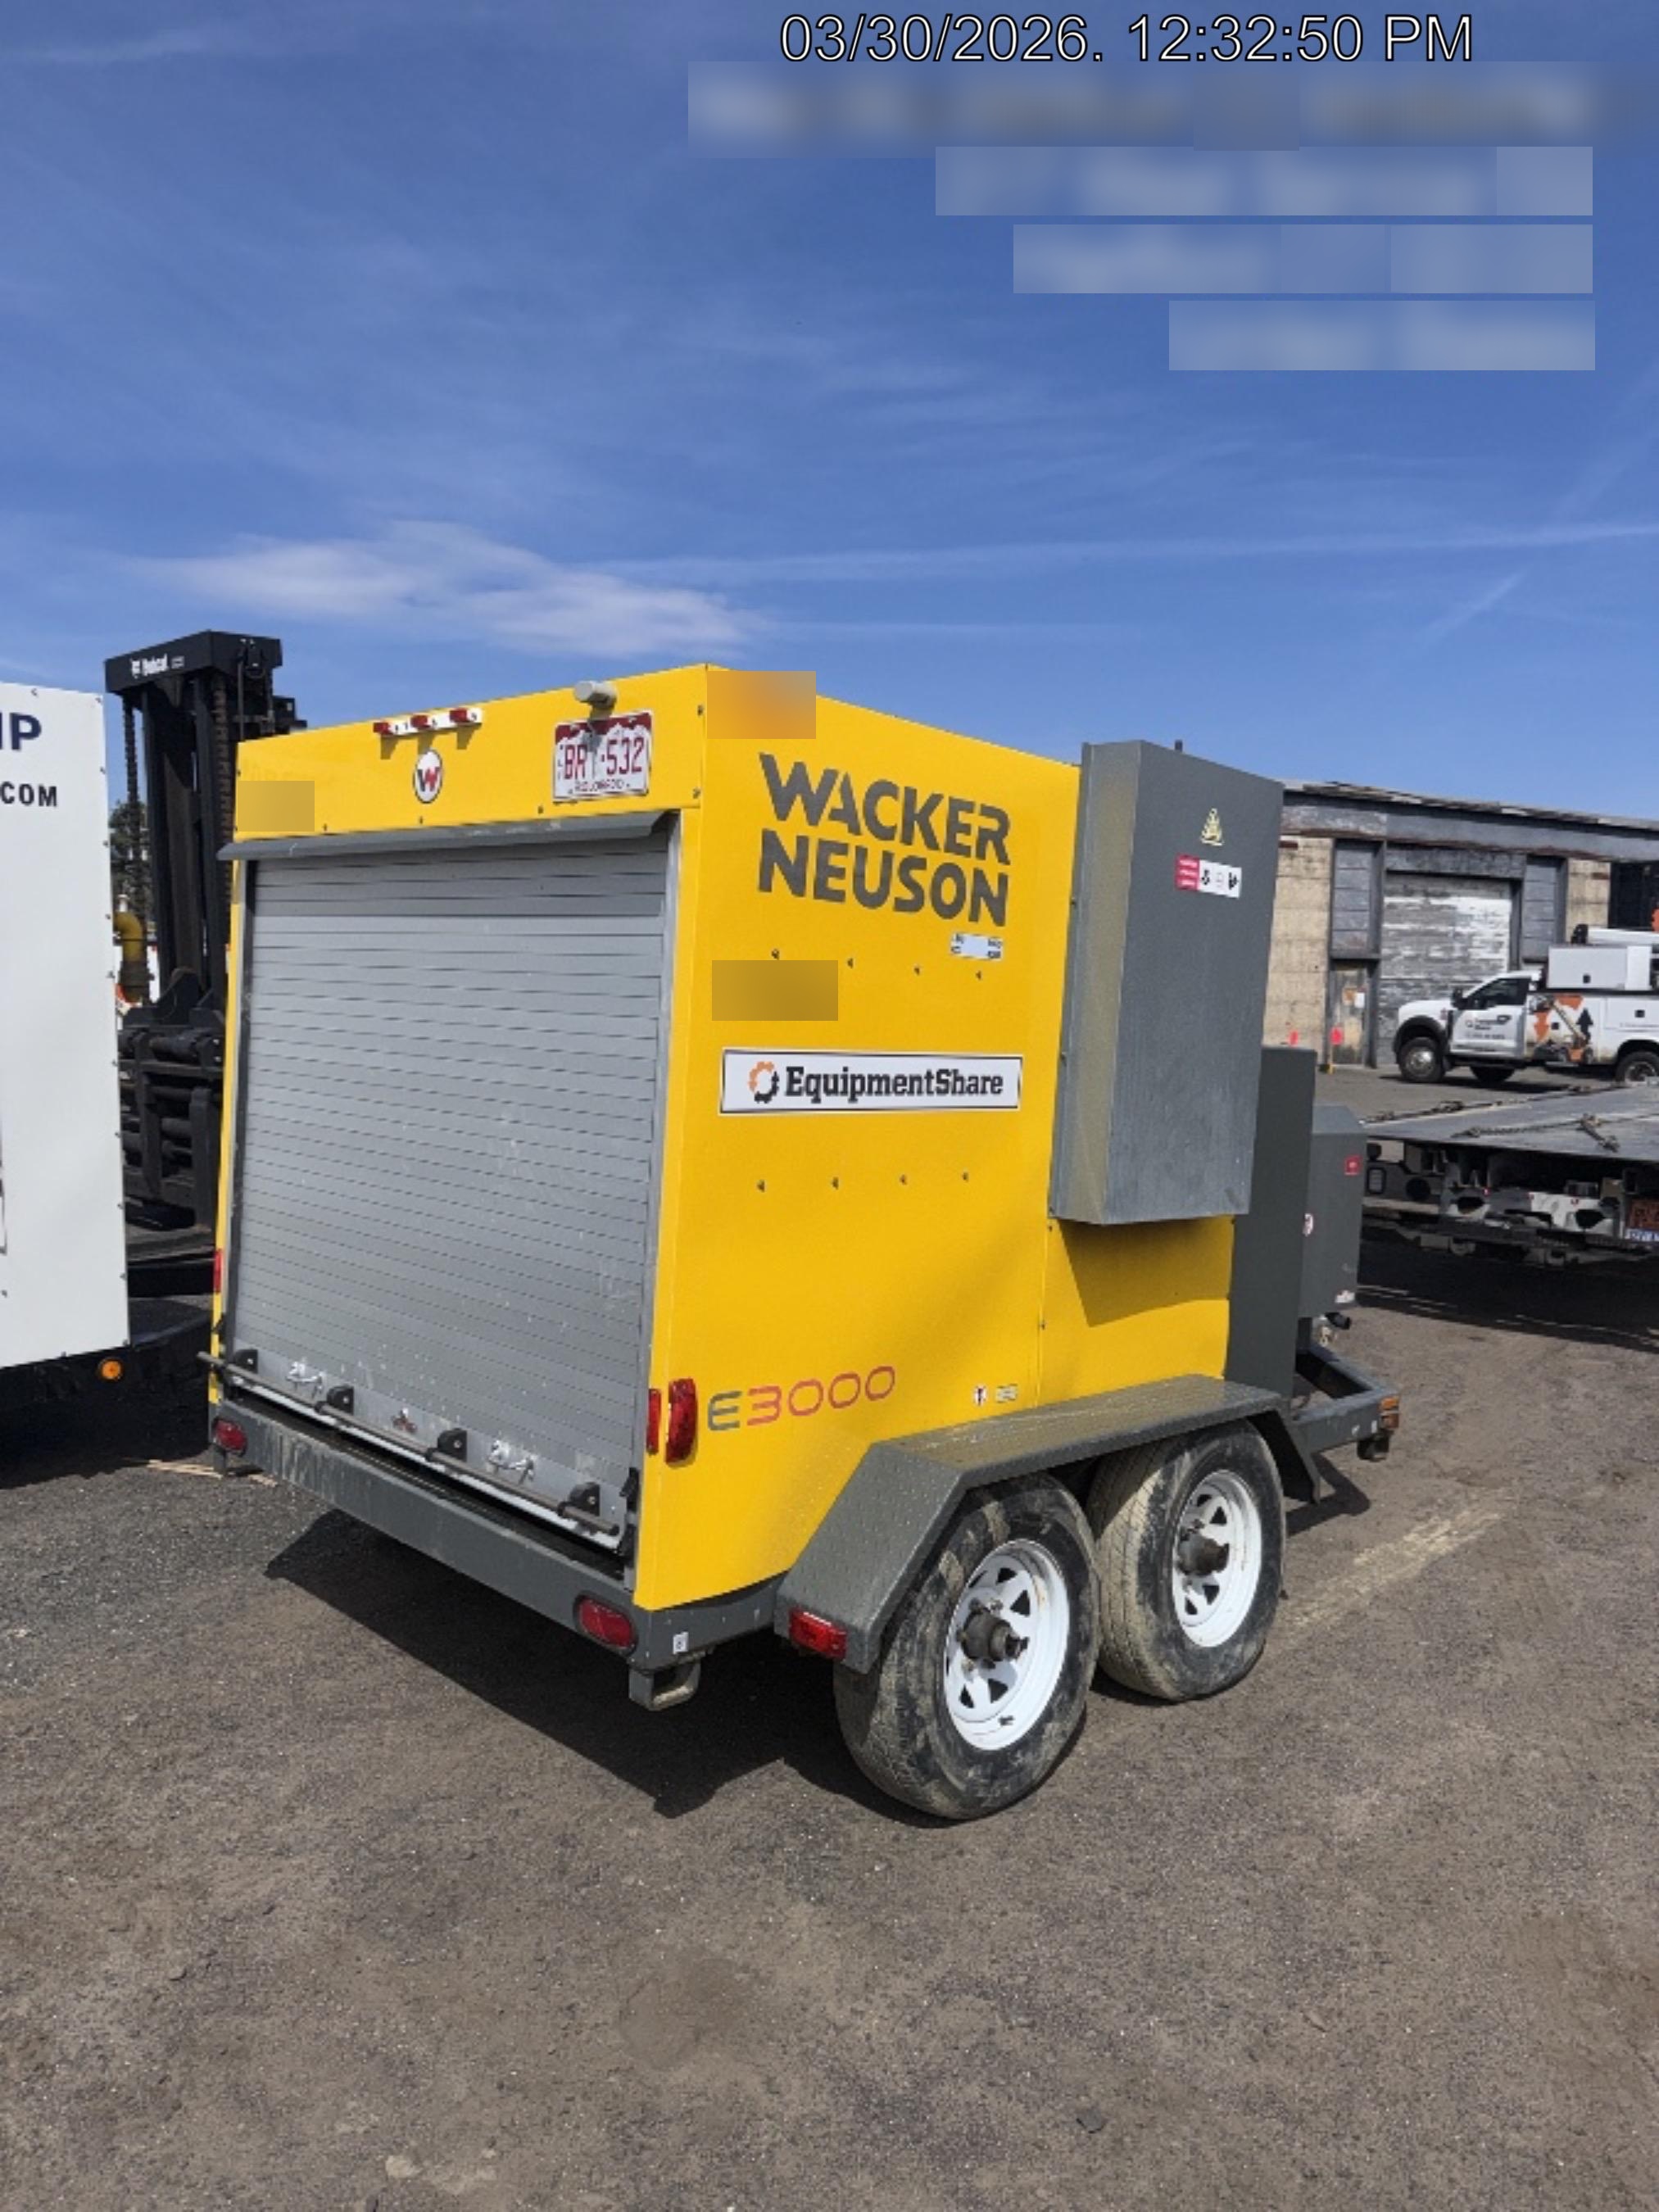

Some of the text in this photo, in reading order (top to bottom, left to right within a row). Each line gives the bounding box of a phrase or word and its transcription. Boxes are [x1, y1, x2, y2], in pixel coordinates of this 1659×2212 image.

[759, 752, 1011, 865] WACKER
[758, 828, 1009, 927] NEUSON
[785, 1066, 1004, 1104] EquipmentShare
[707, 1366, 895, 1430] E3000
